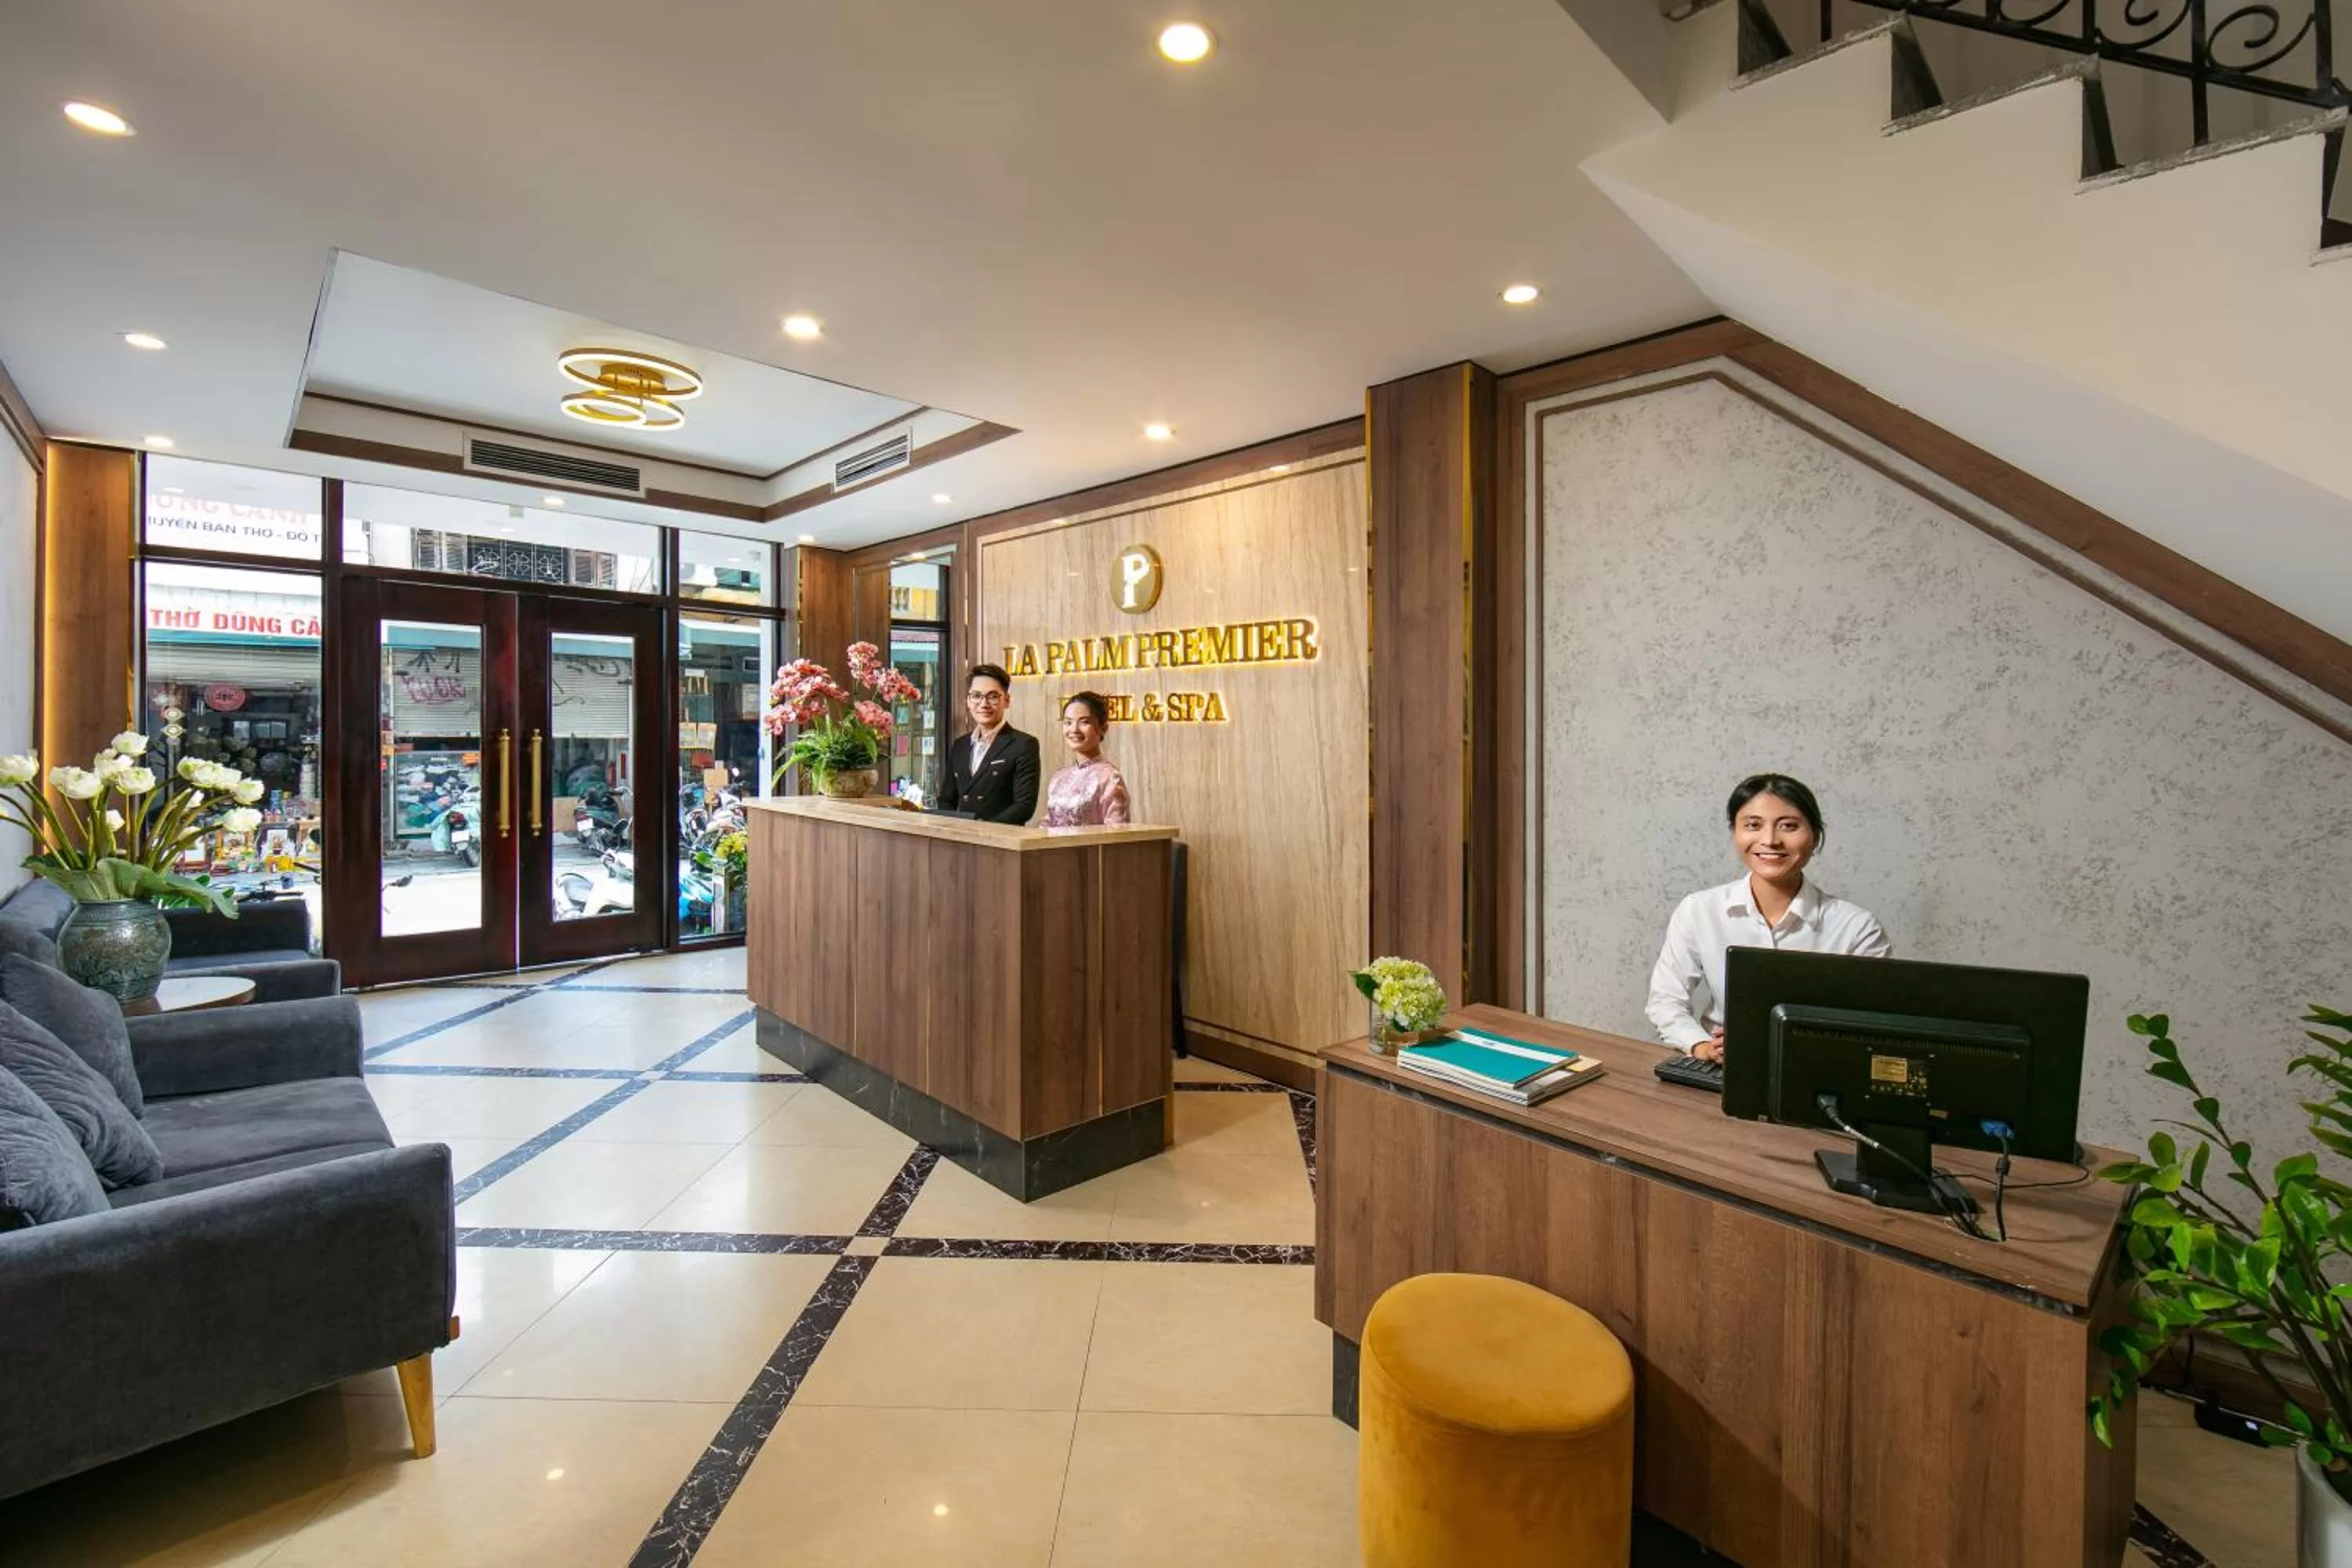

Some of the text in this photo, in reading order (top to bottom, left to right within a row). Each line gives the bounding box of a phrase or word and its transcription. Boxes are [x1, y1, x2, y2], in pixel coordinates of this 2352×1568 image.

[1004, 618, 1319, 676] LA PALM PREMIER
[1142, 692, 1165, 722] &
[1167, 692, 1227, 722] SPA
